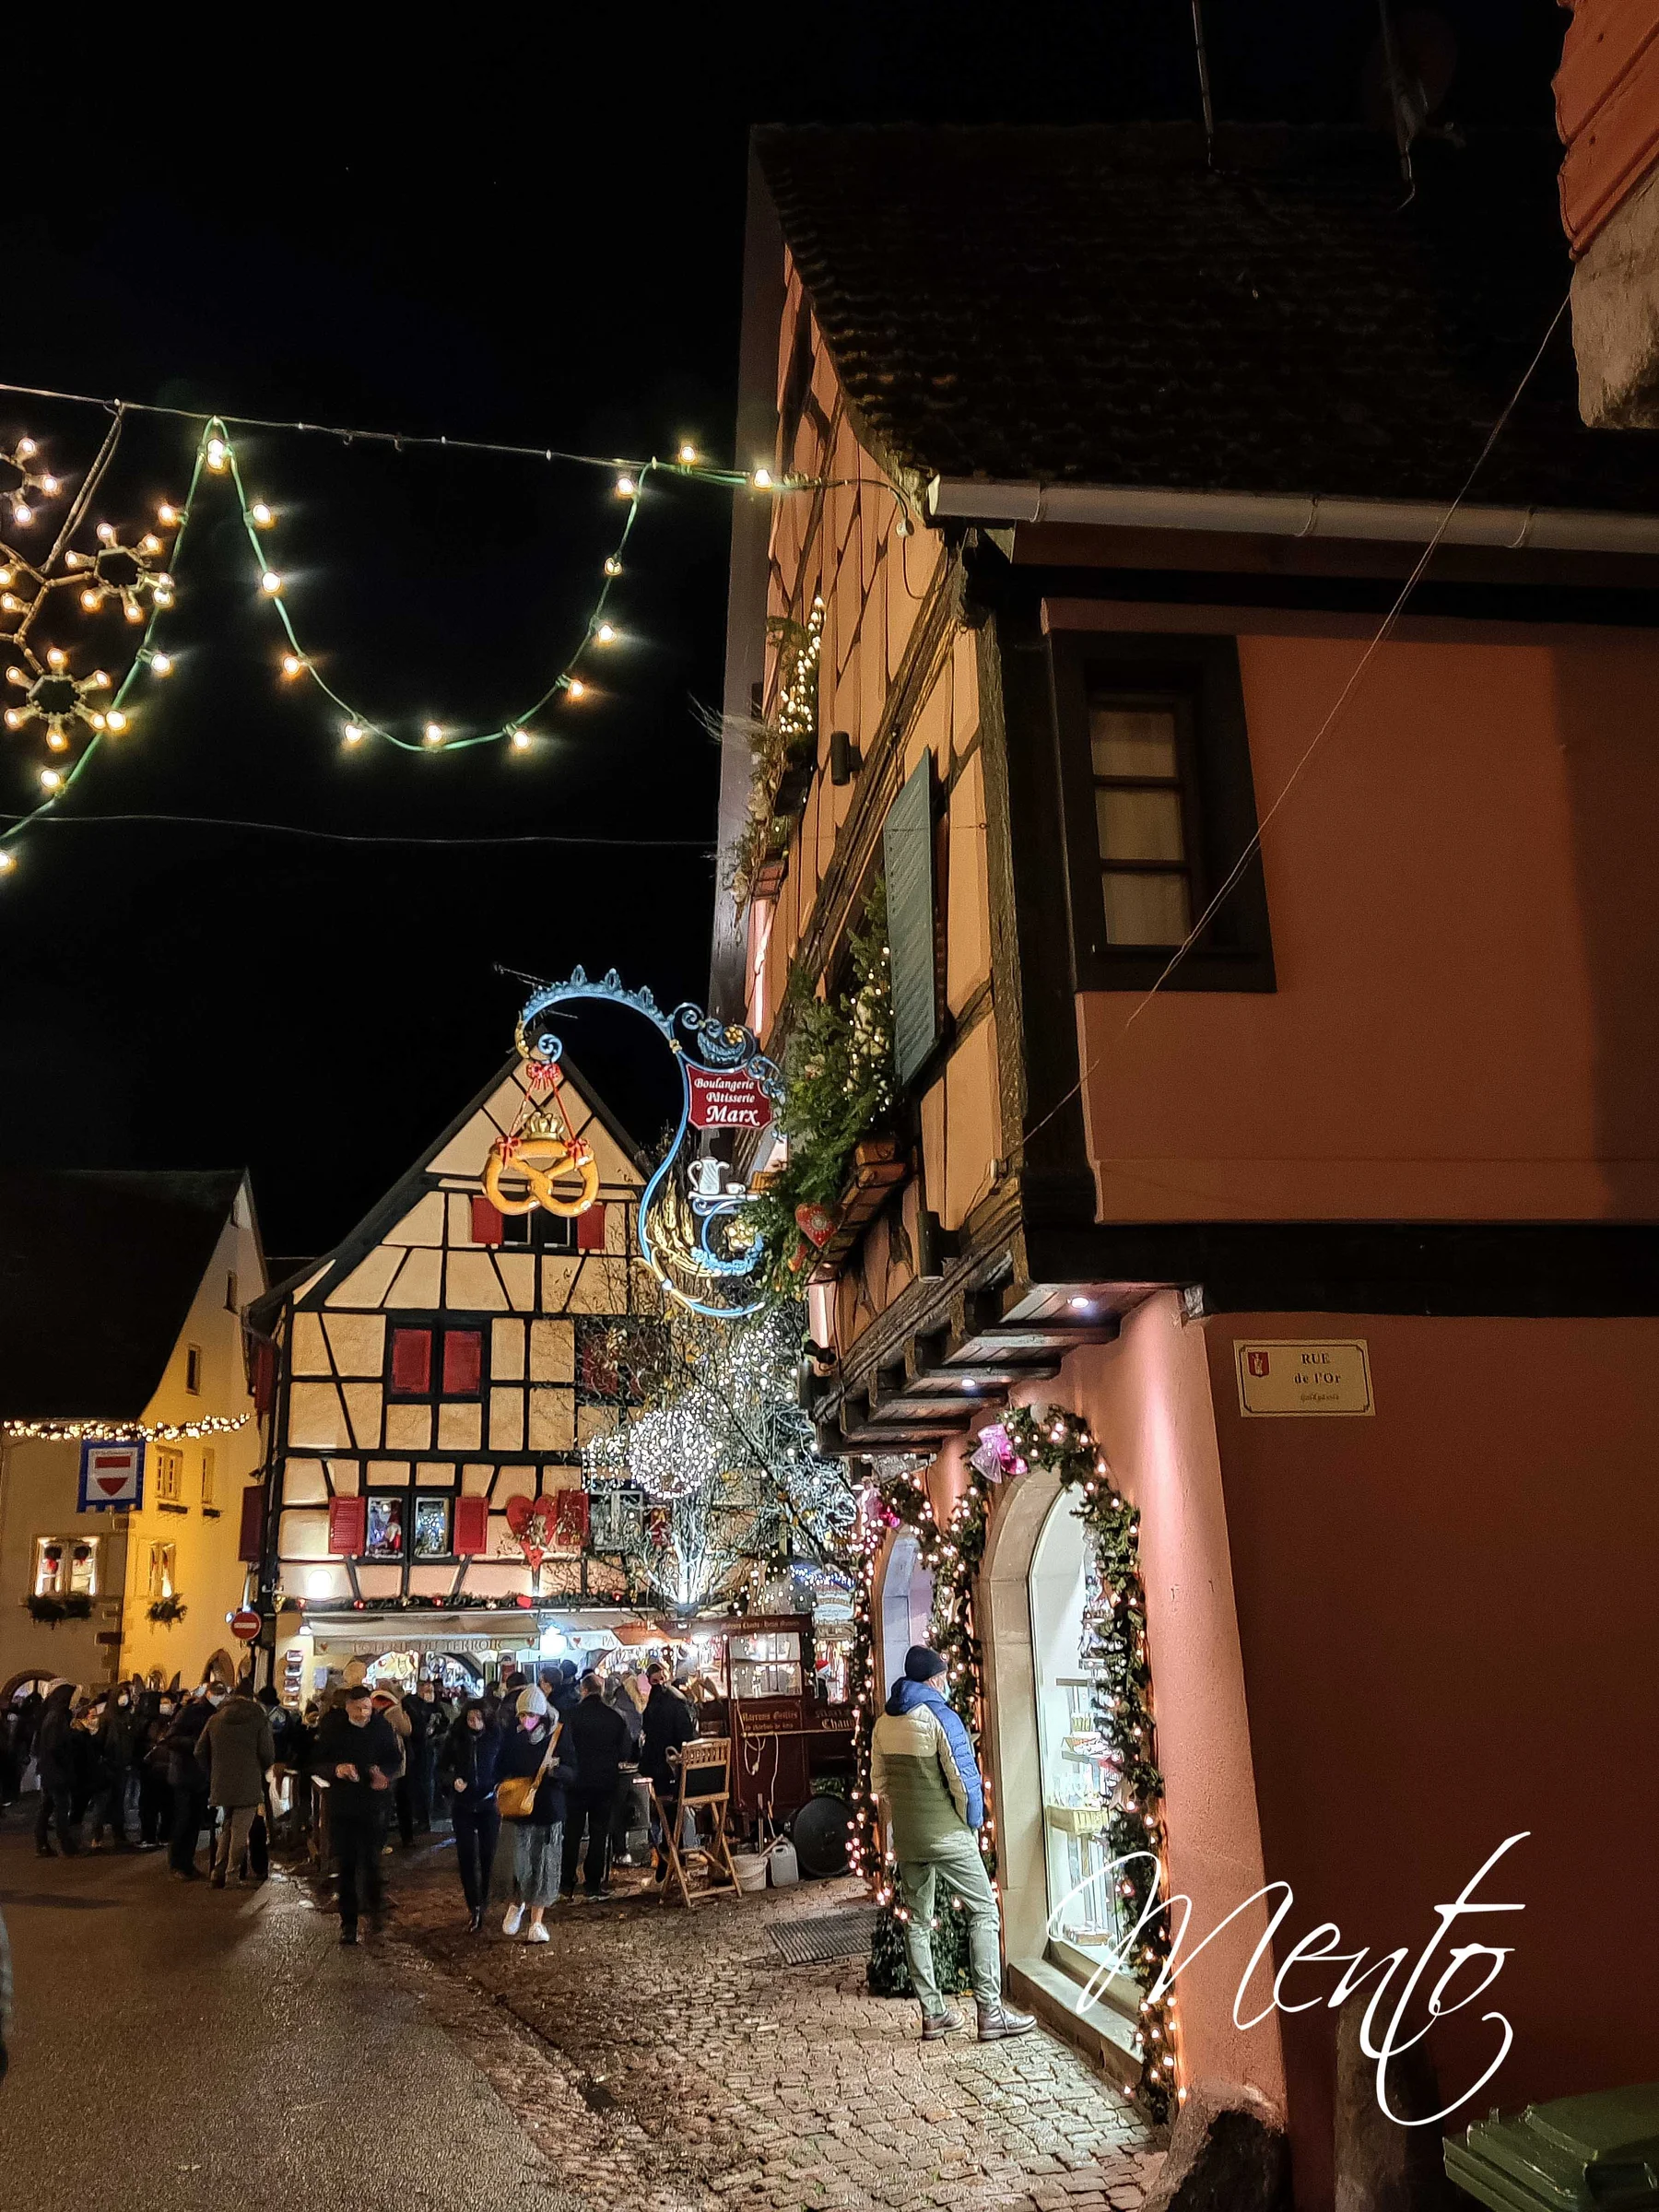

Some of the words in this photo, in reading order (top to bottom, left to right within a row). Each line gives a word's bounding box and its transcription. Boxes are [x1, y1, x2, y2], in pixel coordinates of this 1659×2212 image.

[694, 1077, 754, 1091] Boulangerie
[705, 1105, 760, 1126] Marx
[1301, 1353, 1330, 1365] RUE
[1294, 1372, 1309, 1384] de
[1314, 1372, 1341, 1384] l'Or
[445, 1639, 502, 1651] TERROIR
